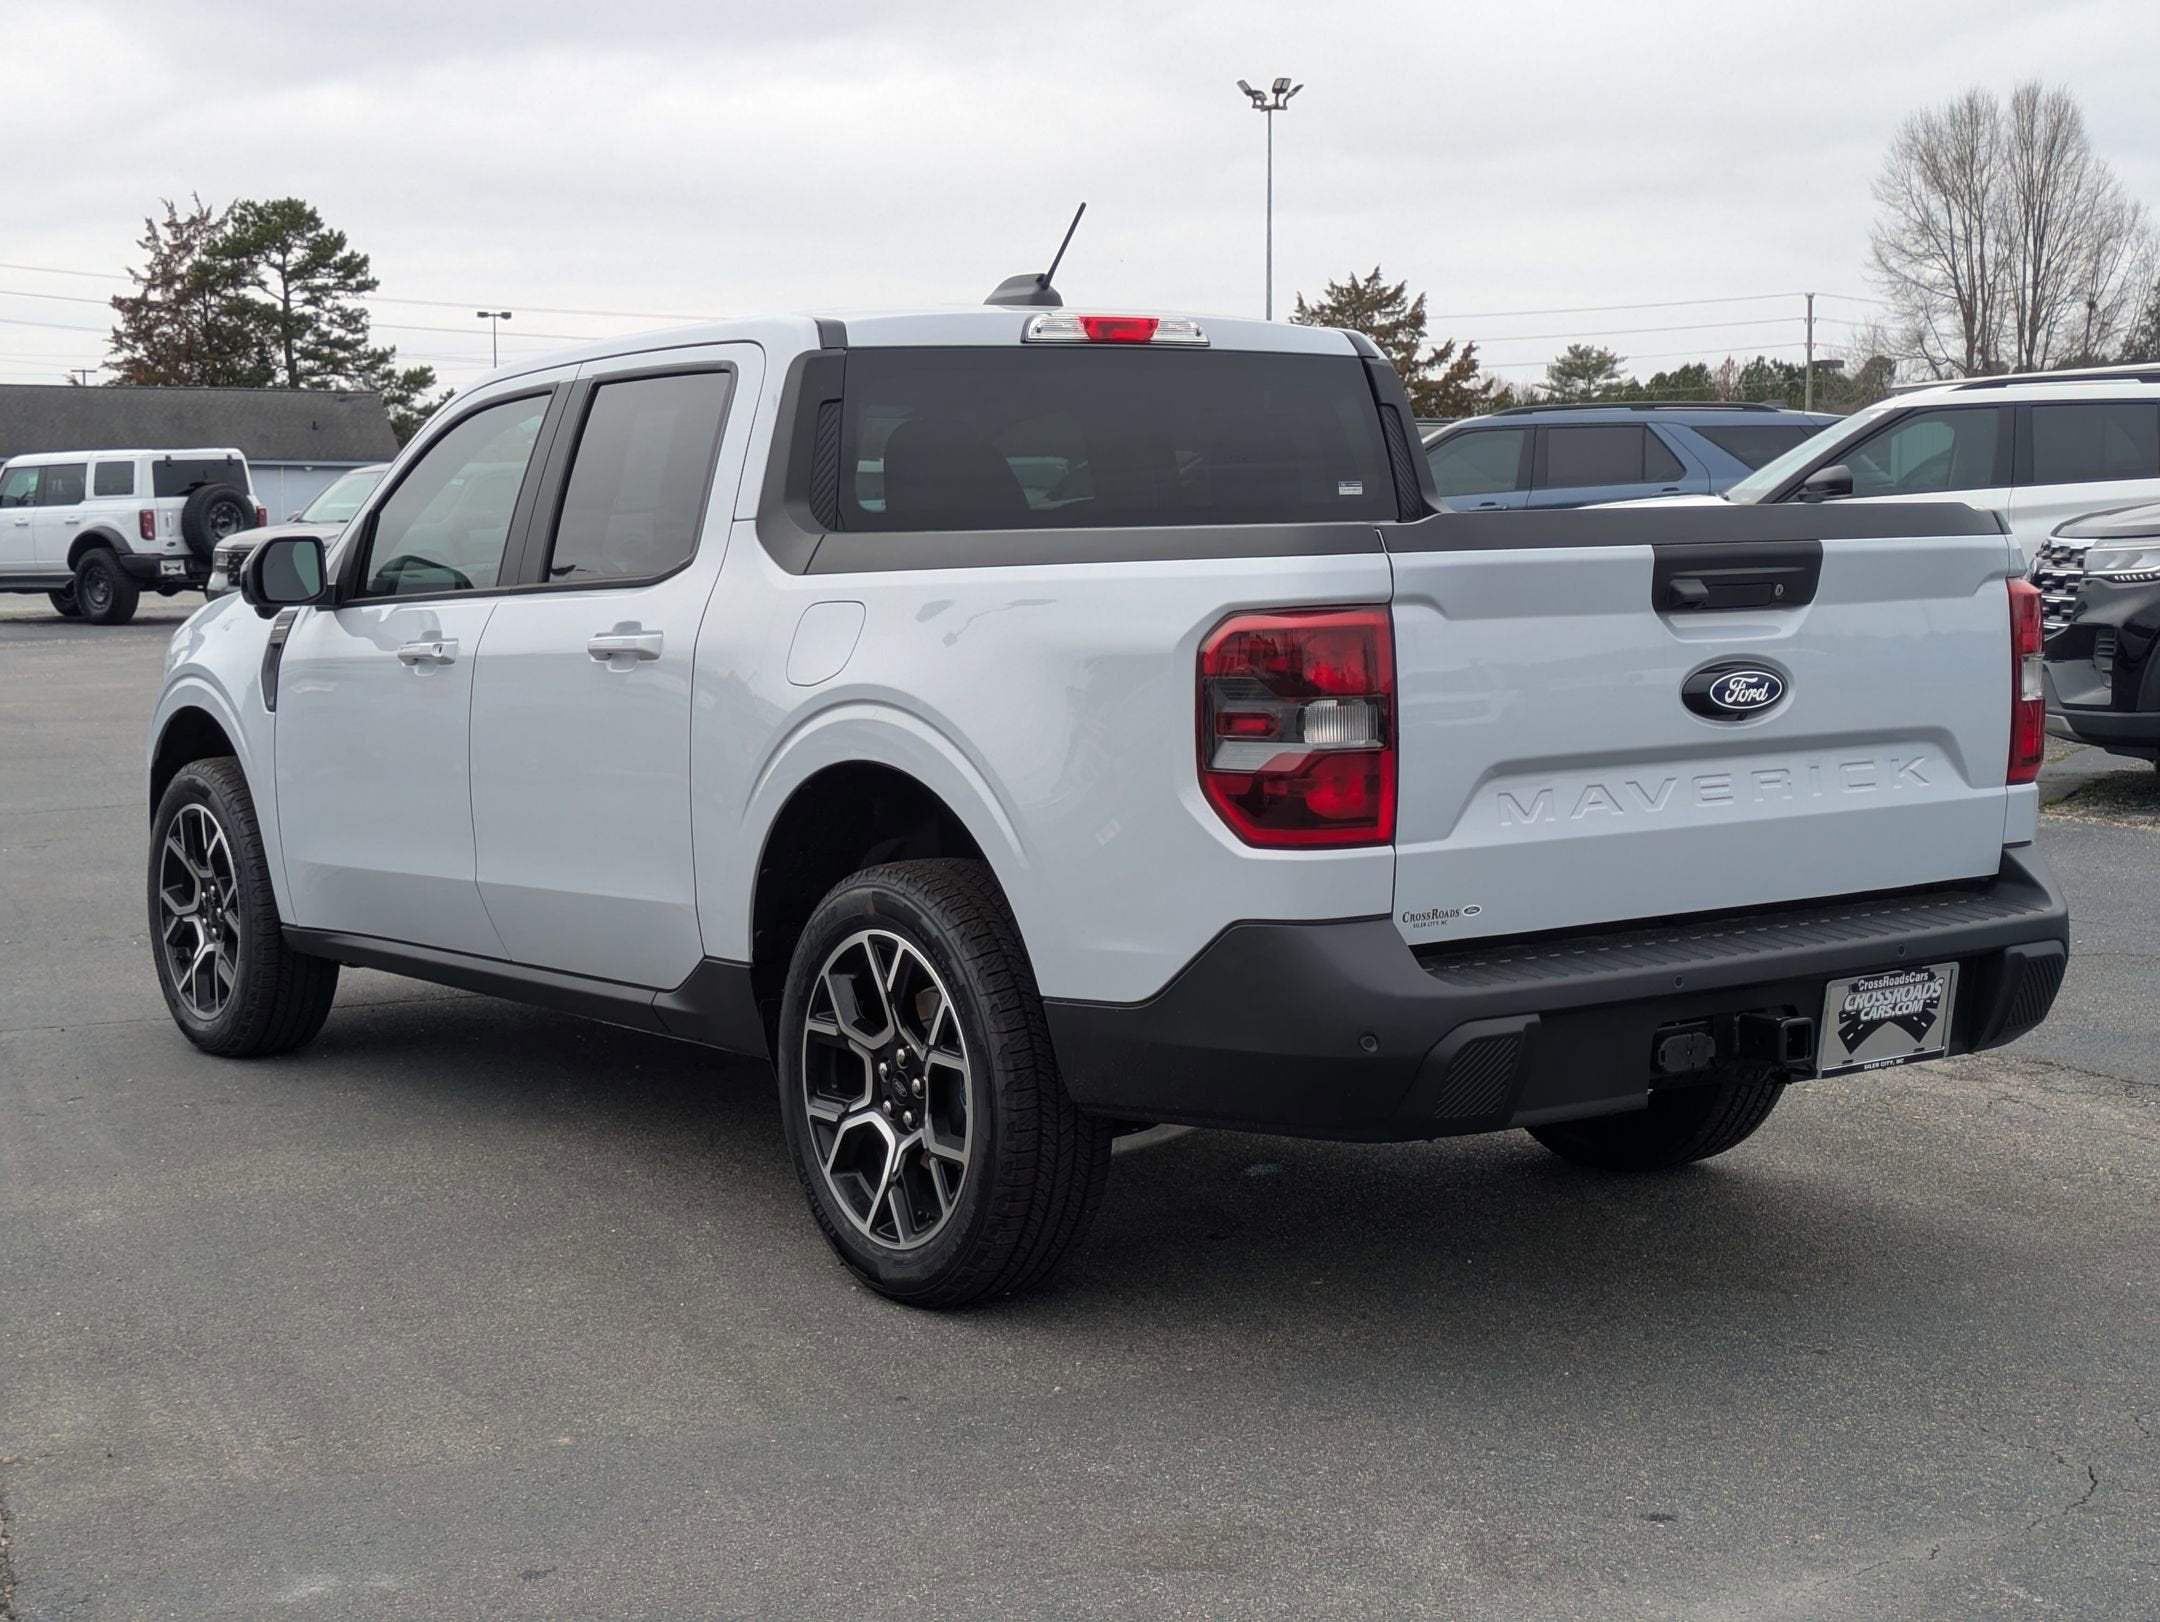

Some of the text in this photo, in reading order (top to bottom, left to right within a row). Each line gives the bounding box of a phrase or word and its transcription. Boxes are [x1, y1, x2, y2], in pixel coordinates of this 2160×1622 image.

[1724, 676, 1770, 704] Ford
[1497, 755, 1930, 827] MAVERICK
[1844, 977, 1944, 1011] CROSSROADS
[1858, 971, 1929, 991] CrossRoadsCars
[1859, 1000, 1925, 1022] CARS.COM
